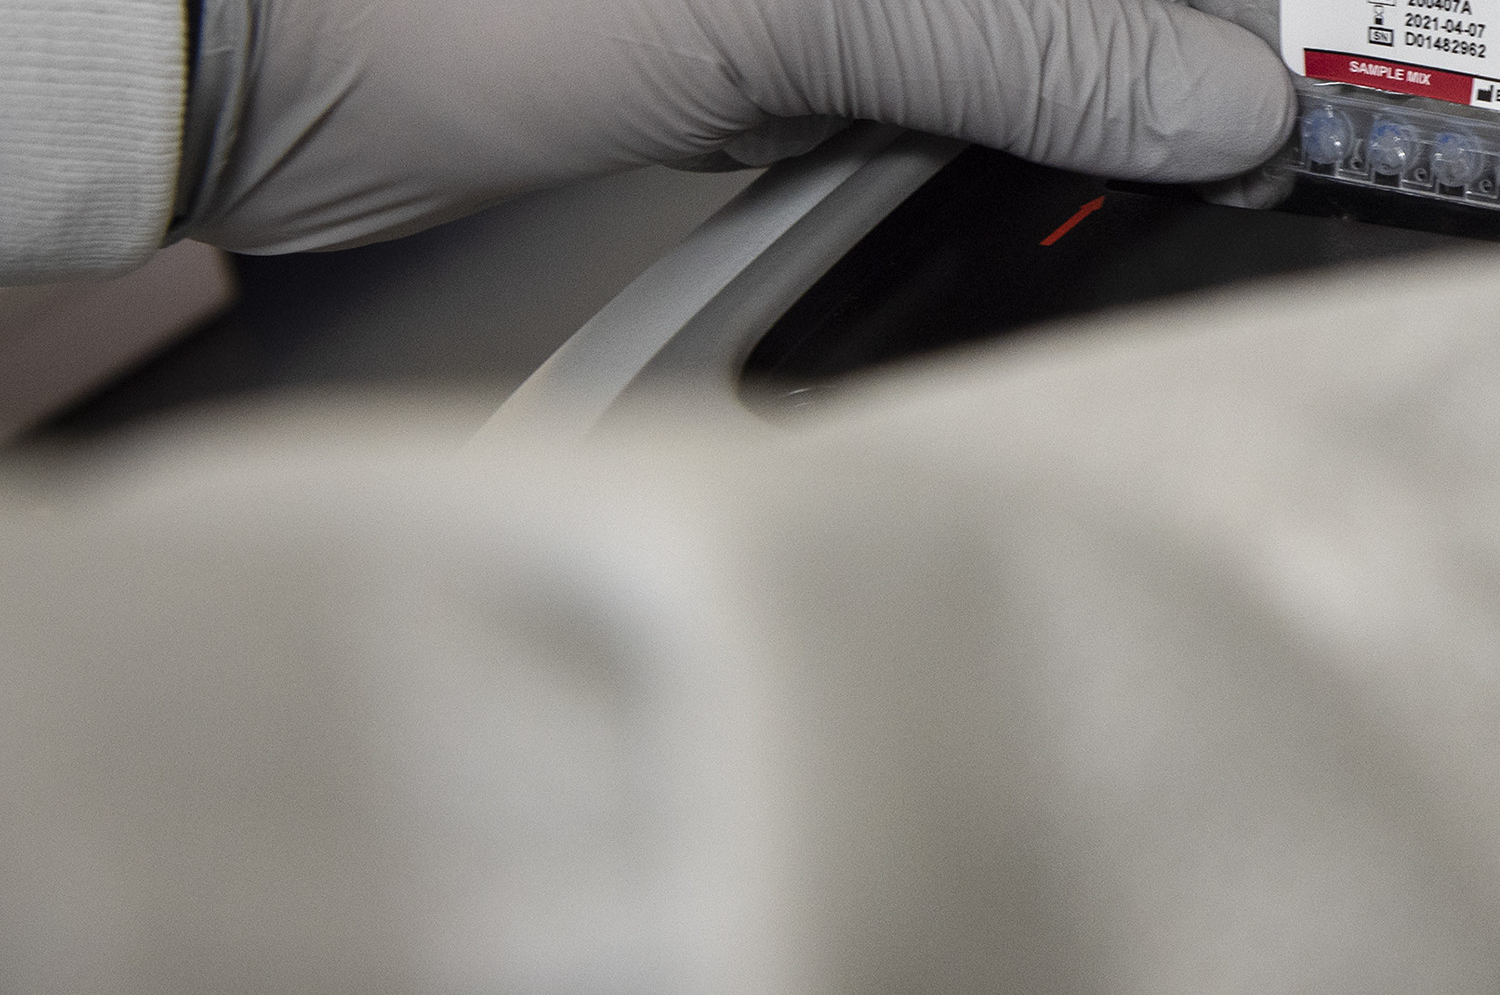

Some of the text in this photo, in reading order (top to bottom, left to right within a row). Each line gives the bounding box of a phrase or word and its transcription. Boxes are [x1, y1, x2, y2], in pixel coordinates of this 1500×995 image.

[1405, 12, 1486, 39] 2021-04-07
[1405, 31, 1487, 59] D01482962
[1349, 60, 1432, 86] SAMPLE MIX
